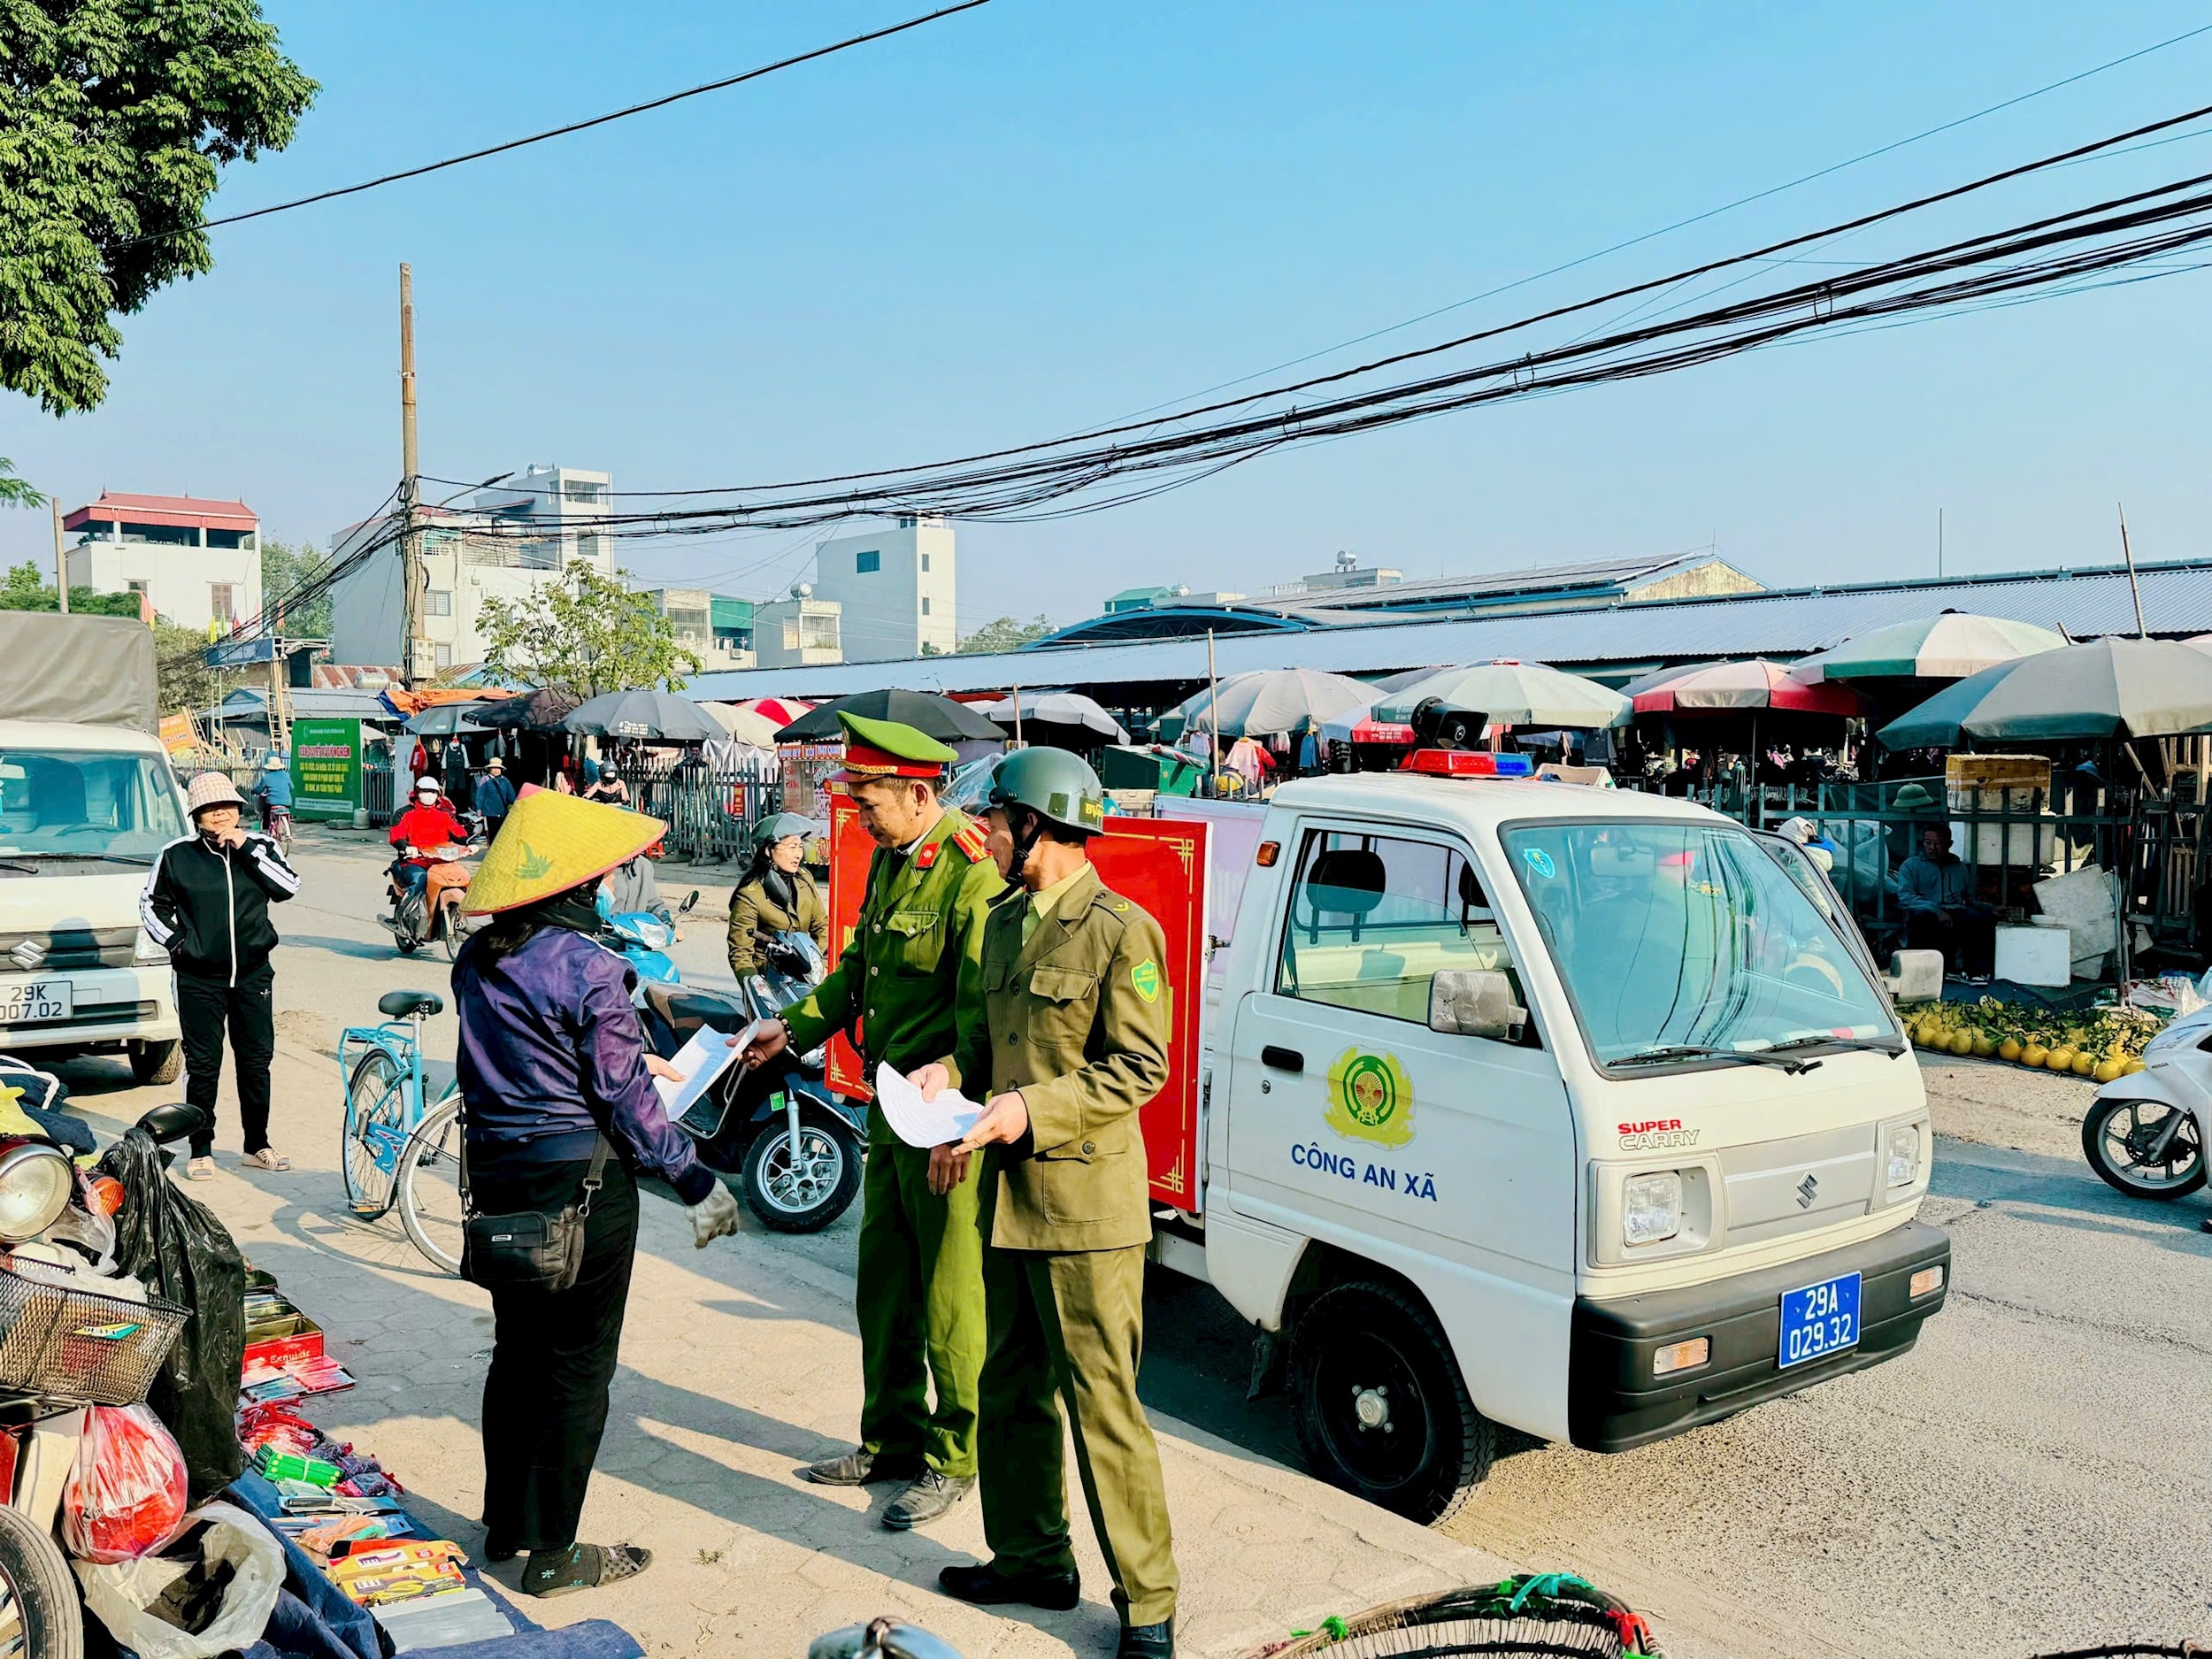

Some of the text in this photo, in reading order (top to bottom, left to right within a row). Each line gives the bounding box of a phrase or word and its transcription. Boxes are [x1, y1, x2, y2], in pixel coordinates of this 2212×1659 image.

[12, 985, 46, 1002] 29K
[1617, 1119, 1681, 1133] SUPER
[1619, 1129, 1700, 1151] CARRY
[1291, 1141, 1438, 1202] CÔNG AN XÃ
[1805, 1283, 1839, 1320] 29A
[1789, 1313, 1852, 1360] 029.32
